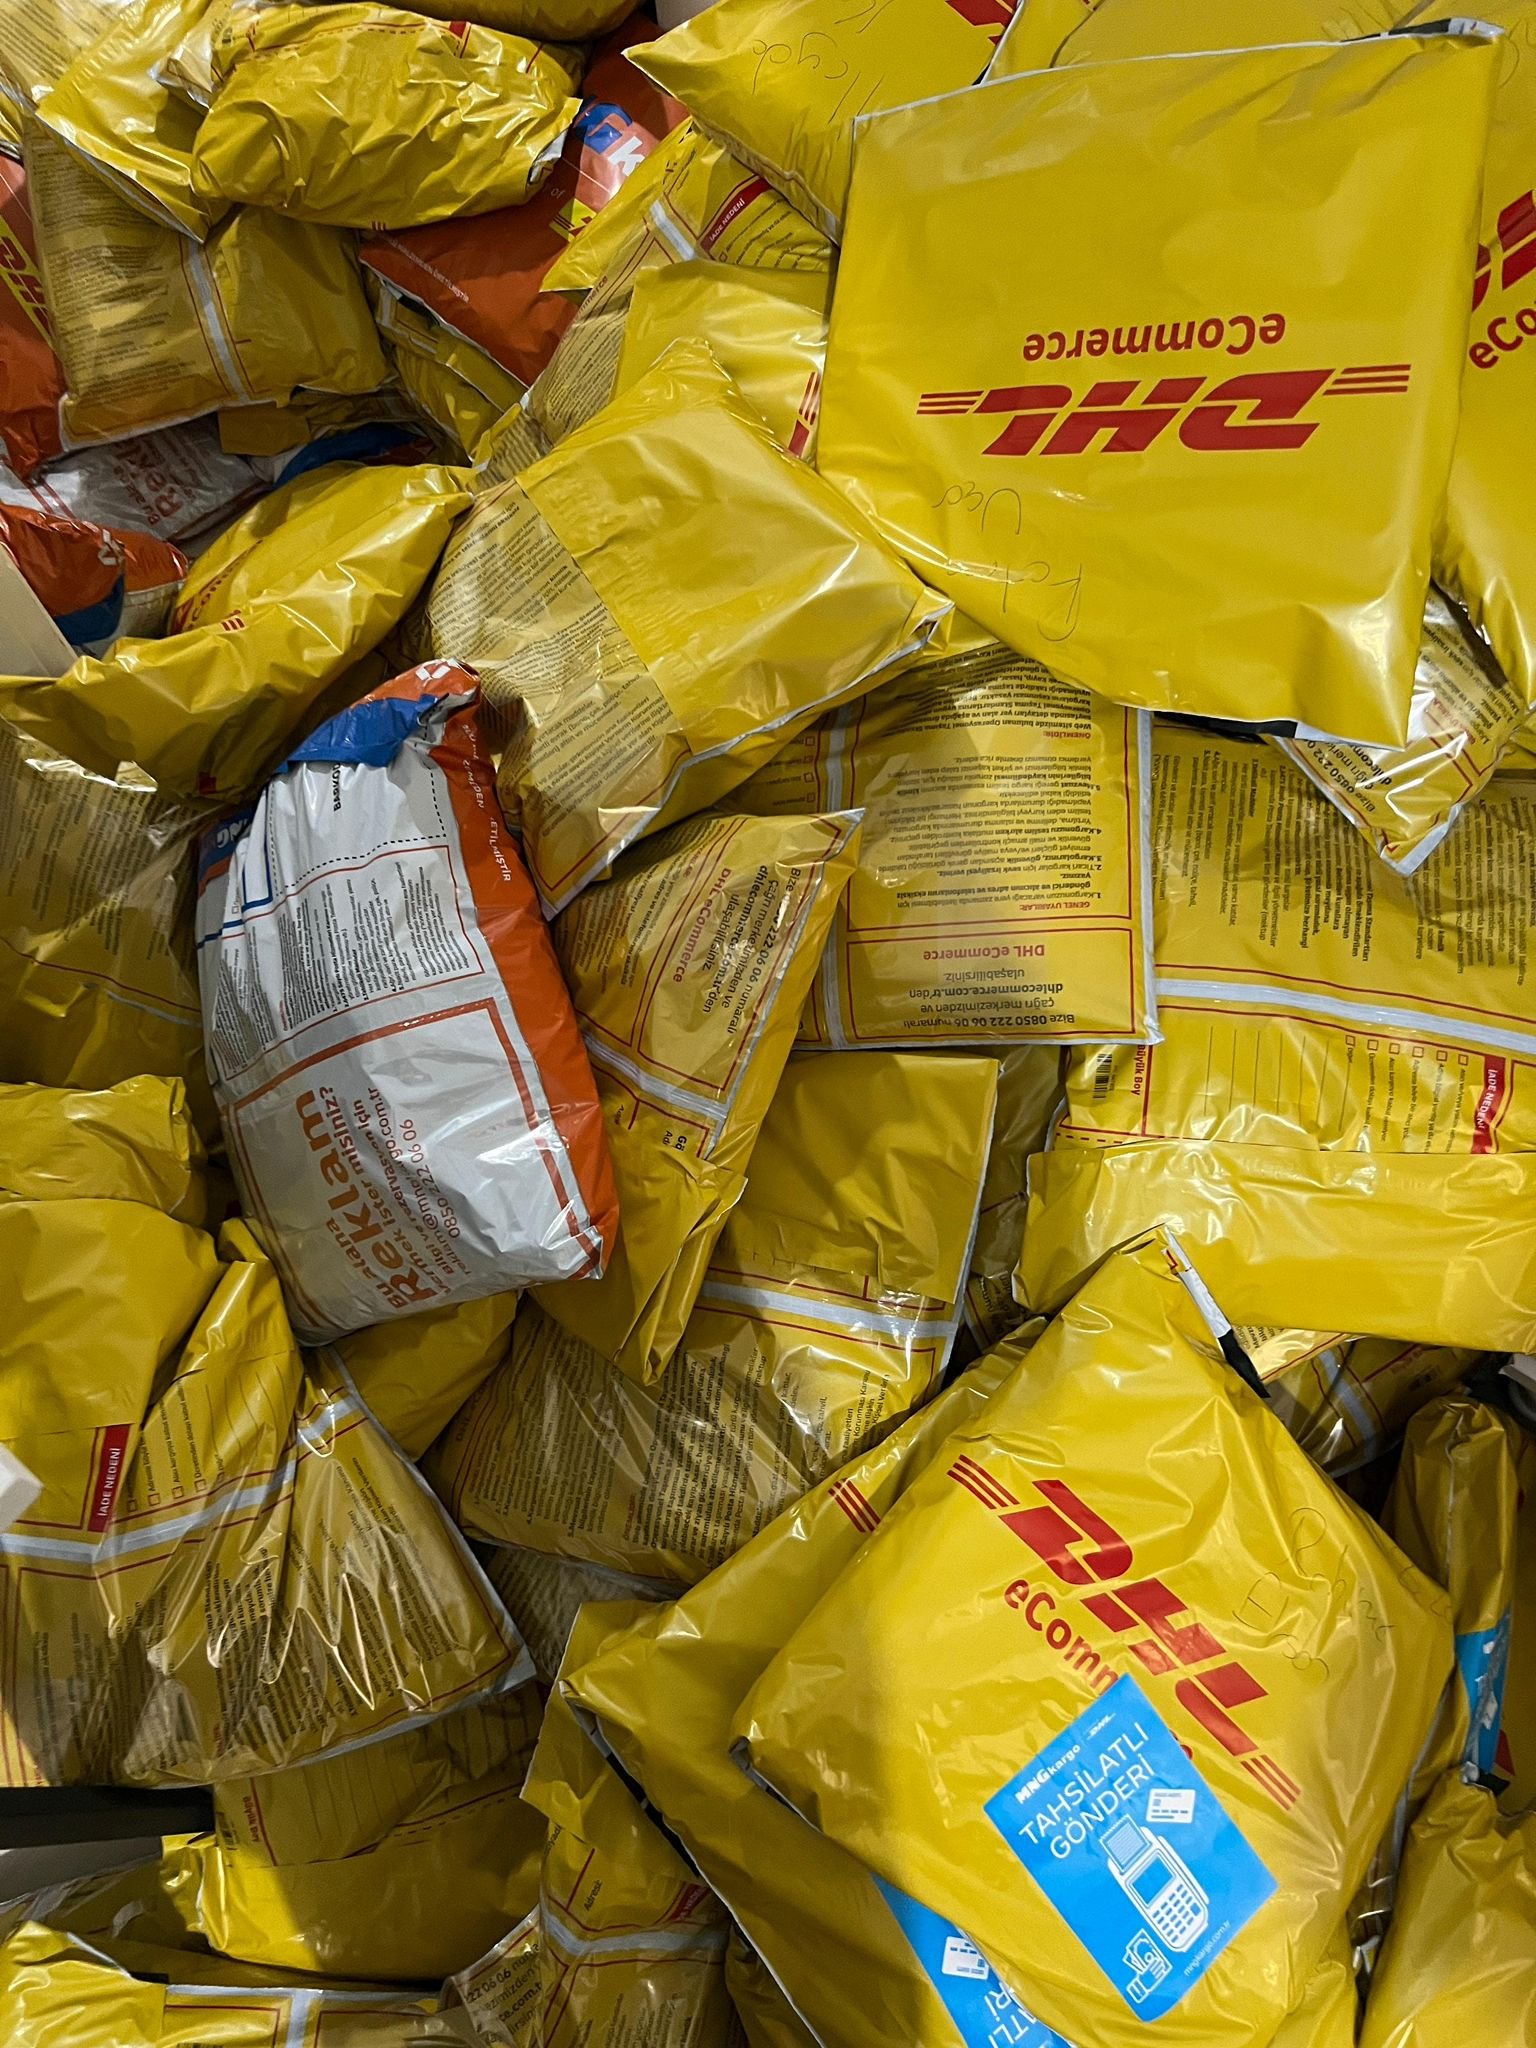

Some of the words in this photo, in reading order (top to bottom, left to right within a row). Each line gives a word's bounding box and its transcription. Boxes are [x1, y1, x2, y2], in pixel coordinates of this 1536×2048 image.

[721, 198, 747, 226] NEDENİ
[1023, 312, 1286, 365] eCommerce
[972, 369, 1337, 458] DHL
[1073, 722, 1091, 730] Web
[1328, 767, 1355, 794] 0850
[709, 865, 731, 899] DHL
[758, 877, 781, 910] çağrı
[782, 865, 802, 894] Bize
[697, 891, 743, 974] ulaşabilirsiniz.
[1340, 906, 1352, 939] olmayan
[670, 896, 716, 984] eCommerce
[725, 907, 771, 995] merkezimizden
[760, 924, 780, 951] 222
[1013, 944, 1044, 957] DHL
[754, 947, 770, 967] 06
[922, 946, 1009, 961] eCommerce
[747, 964, 762, 985] 06
[943, 967, 1024, 982] ulaşabilirsiniz.
[720, 993, 734, 1010] ve
[723, 981, 755, 1036] numaralı
[920, 1004, 933, 1013] ve
[935, 1000, 1021, 1014] merkezimizden
[1024, 996, 1054, 1009] çağrı
[902, 1016, 951, 1029] numaralı
[954, 1018, 968, 1027] 06
[971, 1017, 986, 1026] 06
[989, 1016, 1012, 1026] 222
[1015, 1014, 1047, 1025] 0850
[1049, 1013, 1074, 1024] Bize
[1131, 1078, 1144, 1097] Boy
[1485, 1068, 1498, 1092] İADE
[352, 1099, 371, 1130] için
[319, 1085, 365, 1176] misiniz?
[399, 1119, 418, 1141] 06
[409, 1143, 425, 1164] 06
[416, 1164, 442, 1195] 222
[295, 1089, 439, 1301] Reklam
[361, 1179, 396, 1228] ister
[437, 1197, 461, 1239] 0850
[325, 1217, 378, 1280] alana
[426, 1243, 455, 1276] Bilgi
[376, 1282, 409, 1309] Bu
[103, 1447, 121, 1487] NEDENİ
[96, 1489, 116, 1517] İADE
[723, 1496, 735, 1521] Posta
[998, 1480, 1268, 1757] DHL
[1015, 1743, 1081, 1805] MNGkargo
[1018, 1721, 1150, 1845] TAHSİLATLI
[1050, 1753, 1156, 1859] GÖNDERİ
[1183, 1919, 1232, 1977] mngkargo.com.tr
